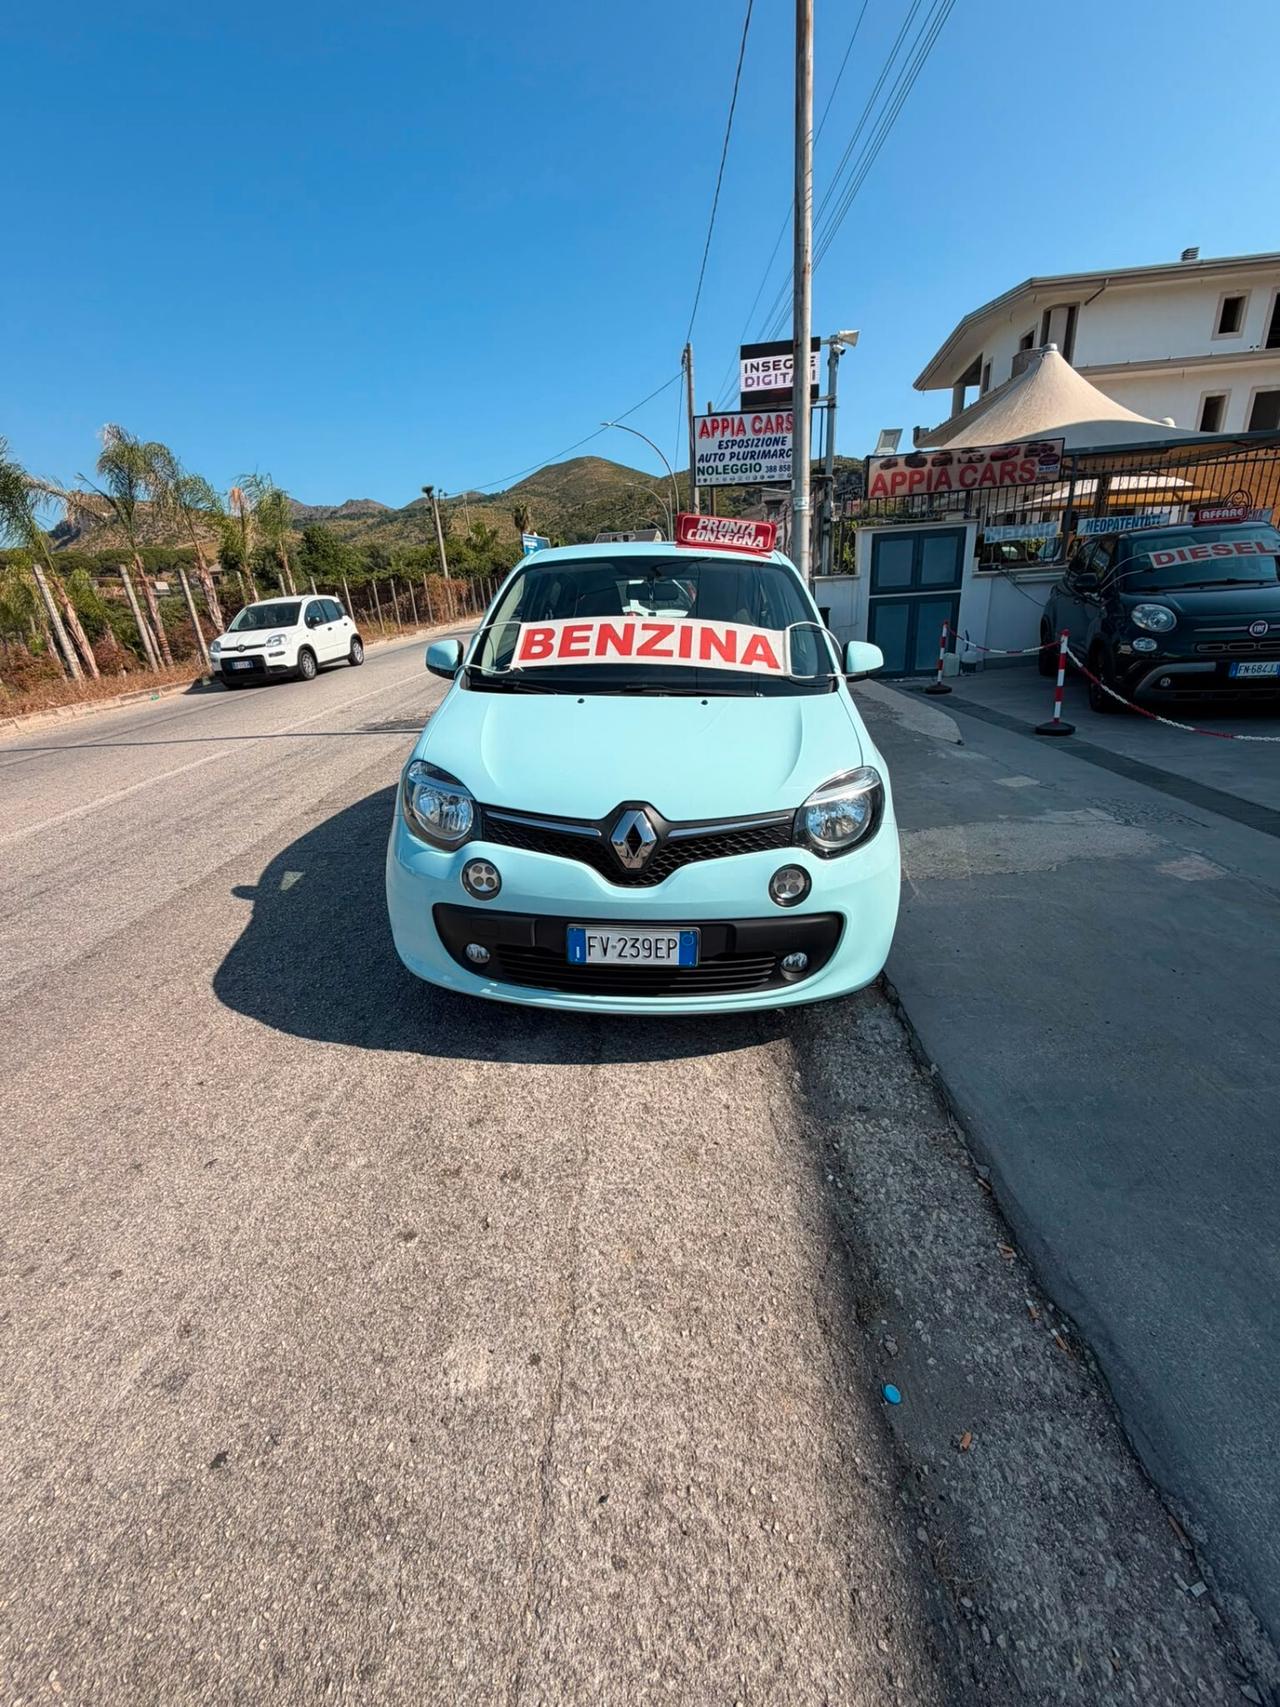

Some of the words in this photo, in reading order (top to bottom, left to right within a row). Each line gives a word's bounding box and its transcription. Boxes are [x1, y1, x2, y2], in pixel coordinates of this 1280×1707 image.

[744, 356, 816, 374] INSEGE
[744, 370, 816, 388] DIGITI
[698, 416, 747, 439] APPIA
[751, 413, 793, 436] CARS
[718, 436, 788, 450] ESPOSIZIONE
[697, 452, 726, 464] AUTO
[729, 448, 793, 462] PLURIMARC
[697, 462, 762, 476] NOLEGGIO
[870, 466, 952, 497] APPIA
[959, 459, 1038, 488] CARS
[1202, 508, 1244, 519] AFFARE
[697, 518, 756, 536] PRONTA
[687, 528, 765, 548] CONSEGNA
[1152, 541, 1277, 566] DIESEL
[518, 623, 782, 669] BENZINA
